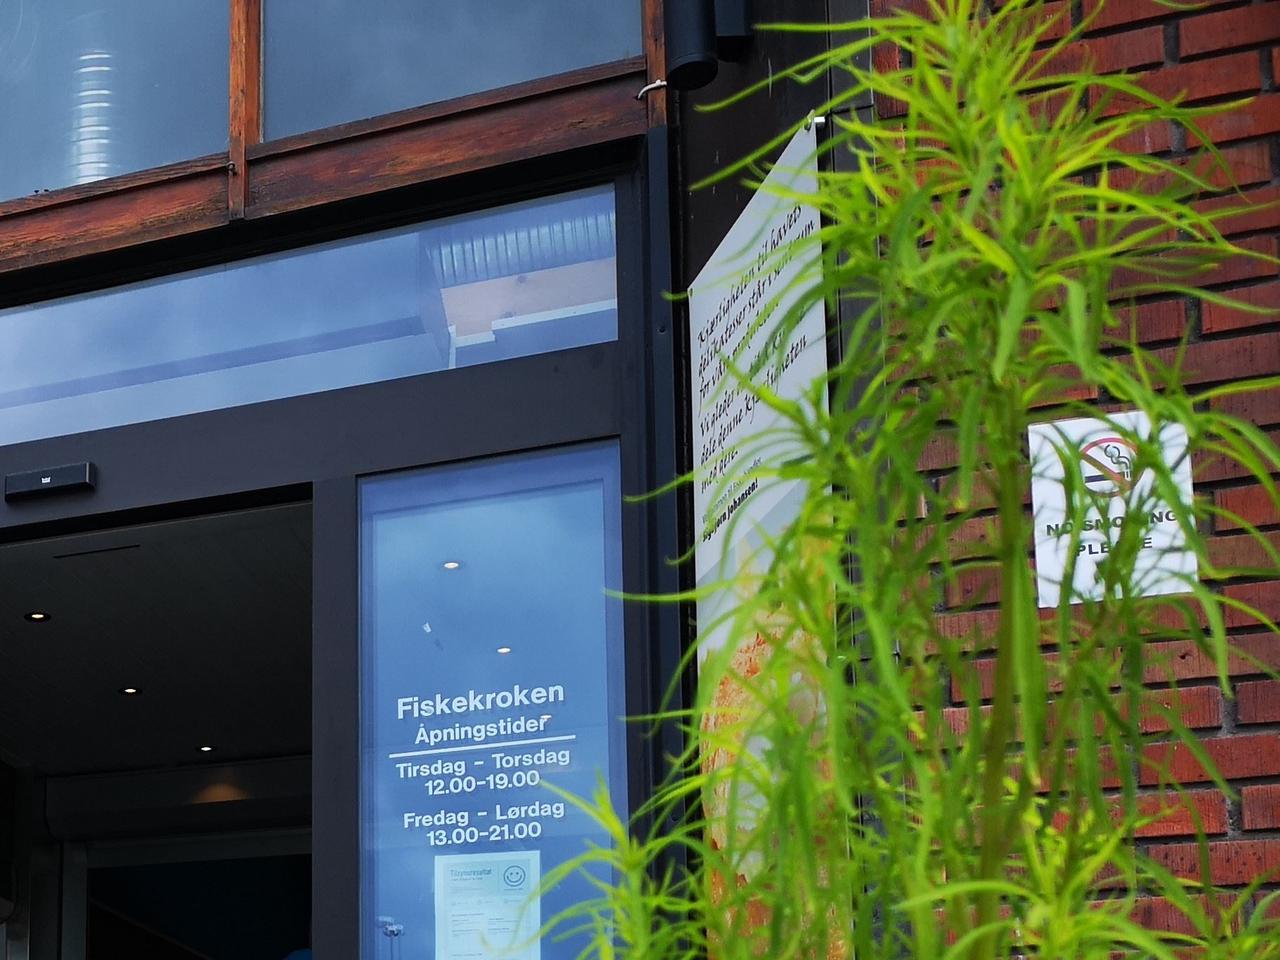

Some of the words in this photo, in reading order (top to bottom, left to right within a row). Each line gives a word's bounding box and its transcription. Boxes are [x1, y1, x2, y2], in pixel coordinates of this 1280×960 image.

[771, 202, 801, 252] havets
[700, 413, 709, 437] Vi
[397, 684, 564, 720] Fiskekroken
[414, 716, 547, 746] Åpningstider
[396, 760, 467, 779] Tirsdag
[492, 748, 571, 769] Torsdag
[424, 770, 540, 796] 12.00-19.00
[403, 810, 469, 828] Fredag
[496, 801, 566, 821] Lørdag
[426, 822, 542, 846] 13.00-21.00
